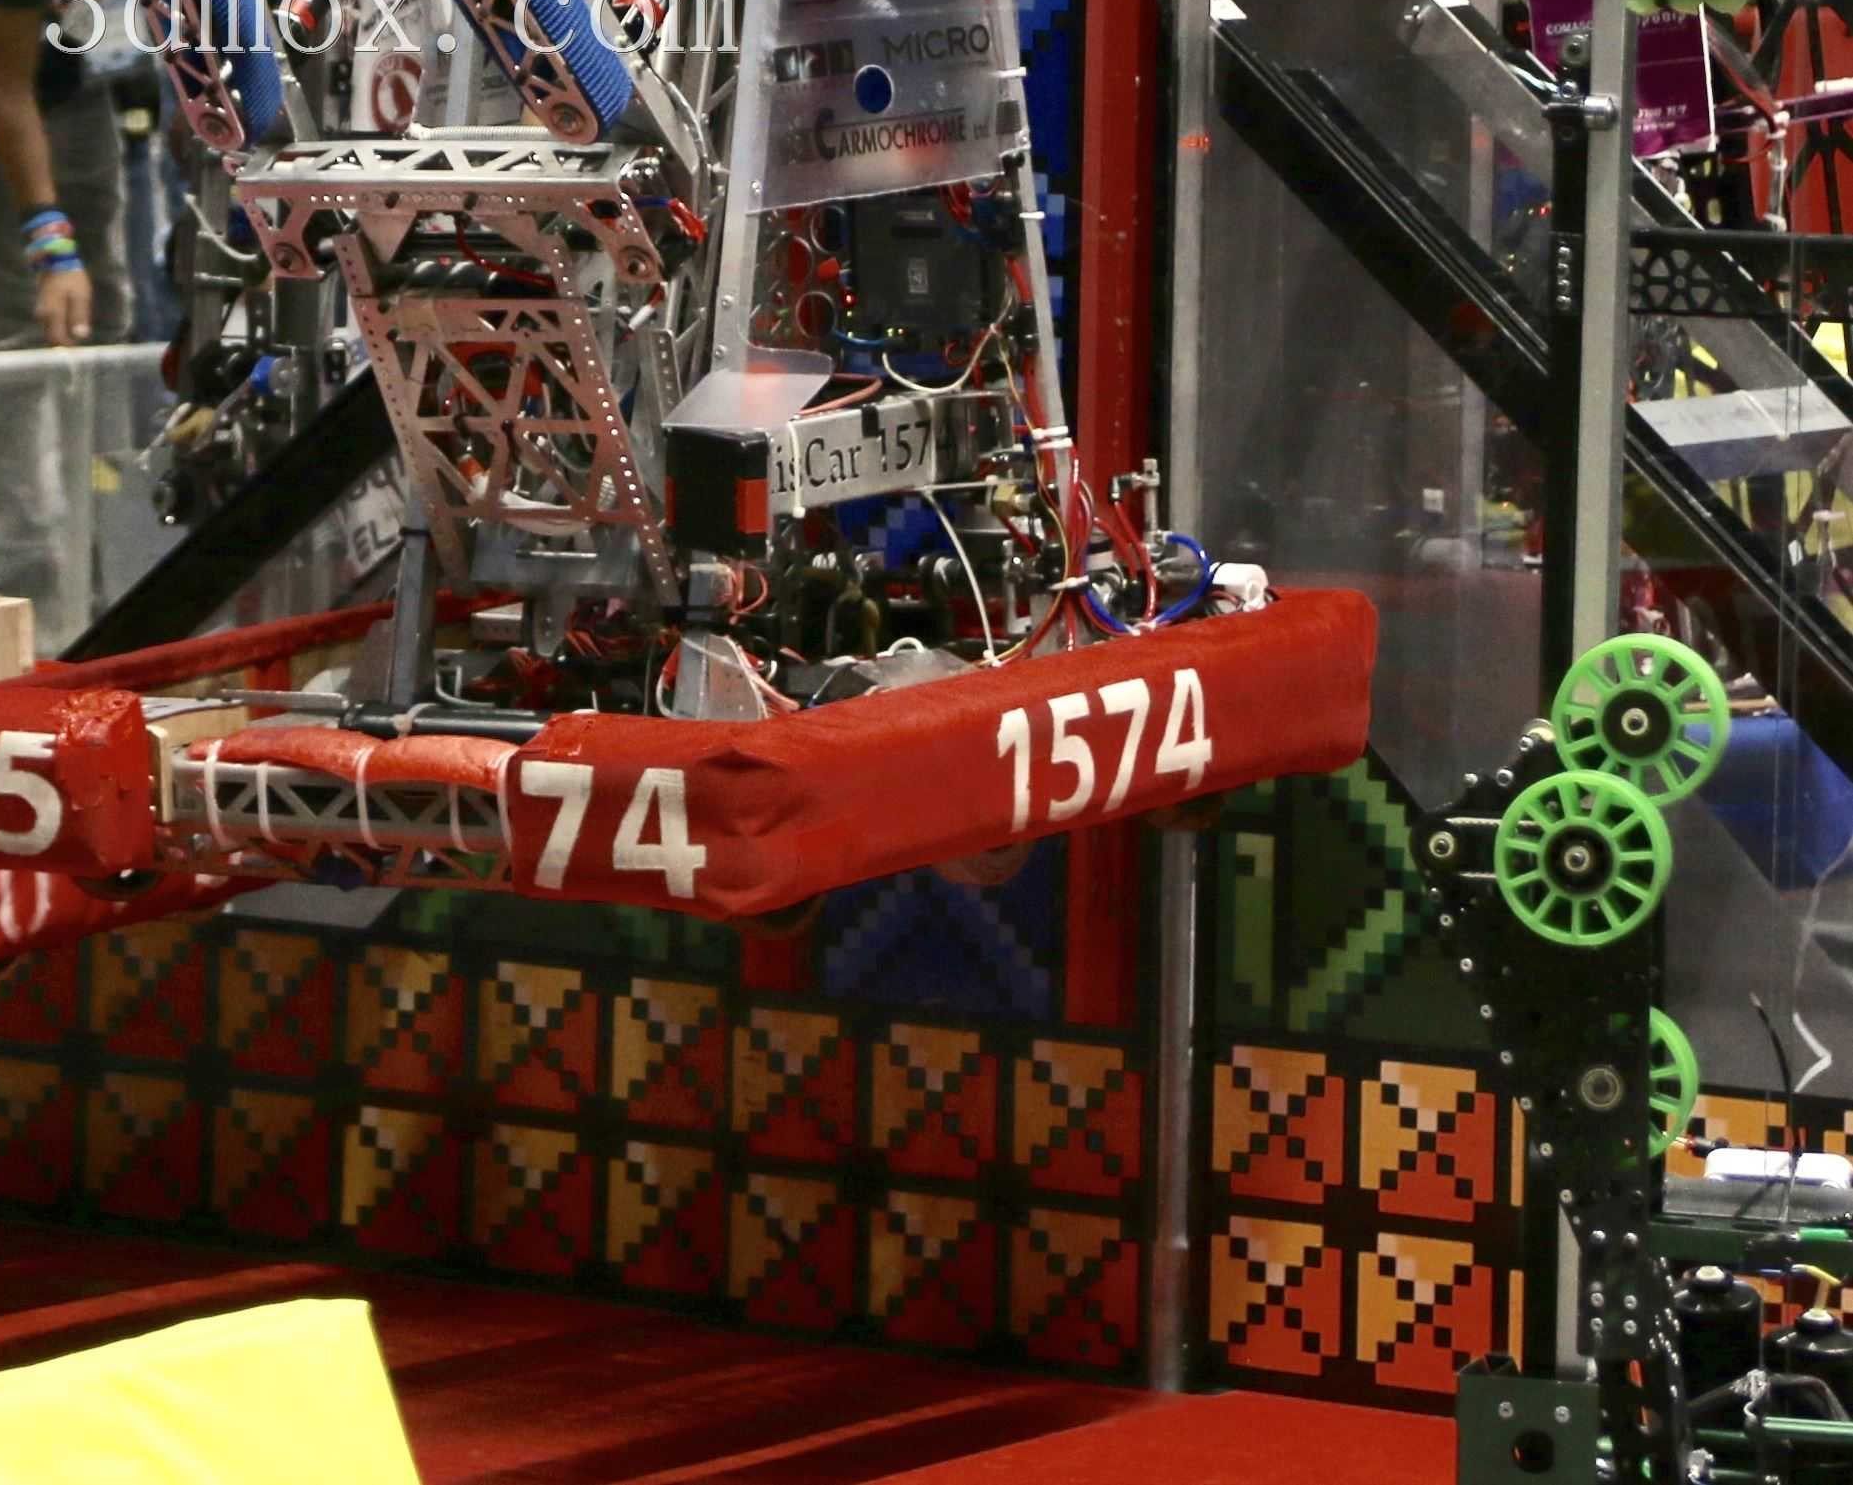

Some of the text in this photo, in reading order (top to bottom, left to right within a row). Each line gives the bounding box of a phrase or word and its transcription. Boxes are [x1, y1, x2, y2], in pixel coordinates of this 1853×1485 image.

[881, 23, 991, 66] MICRO
[997, 668, 1214, 834] 1574
[520, 760, 707, 899] 74
